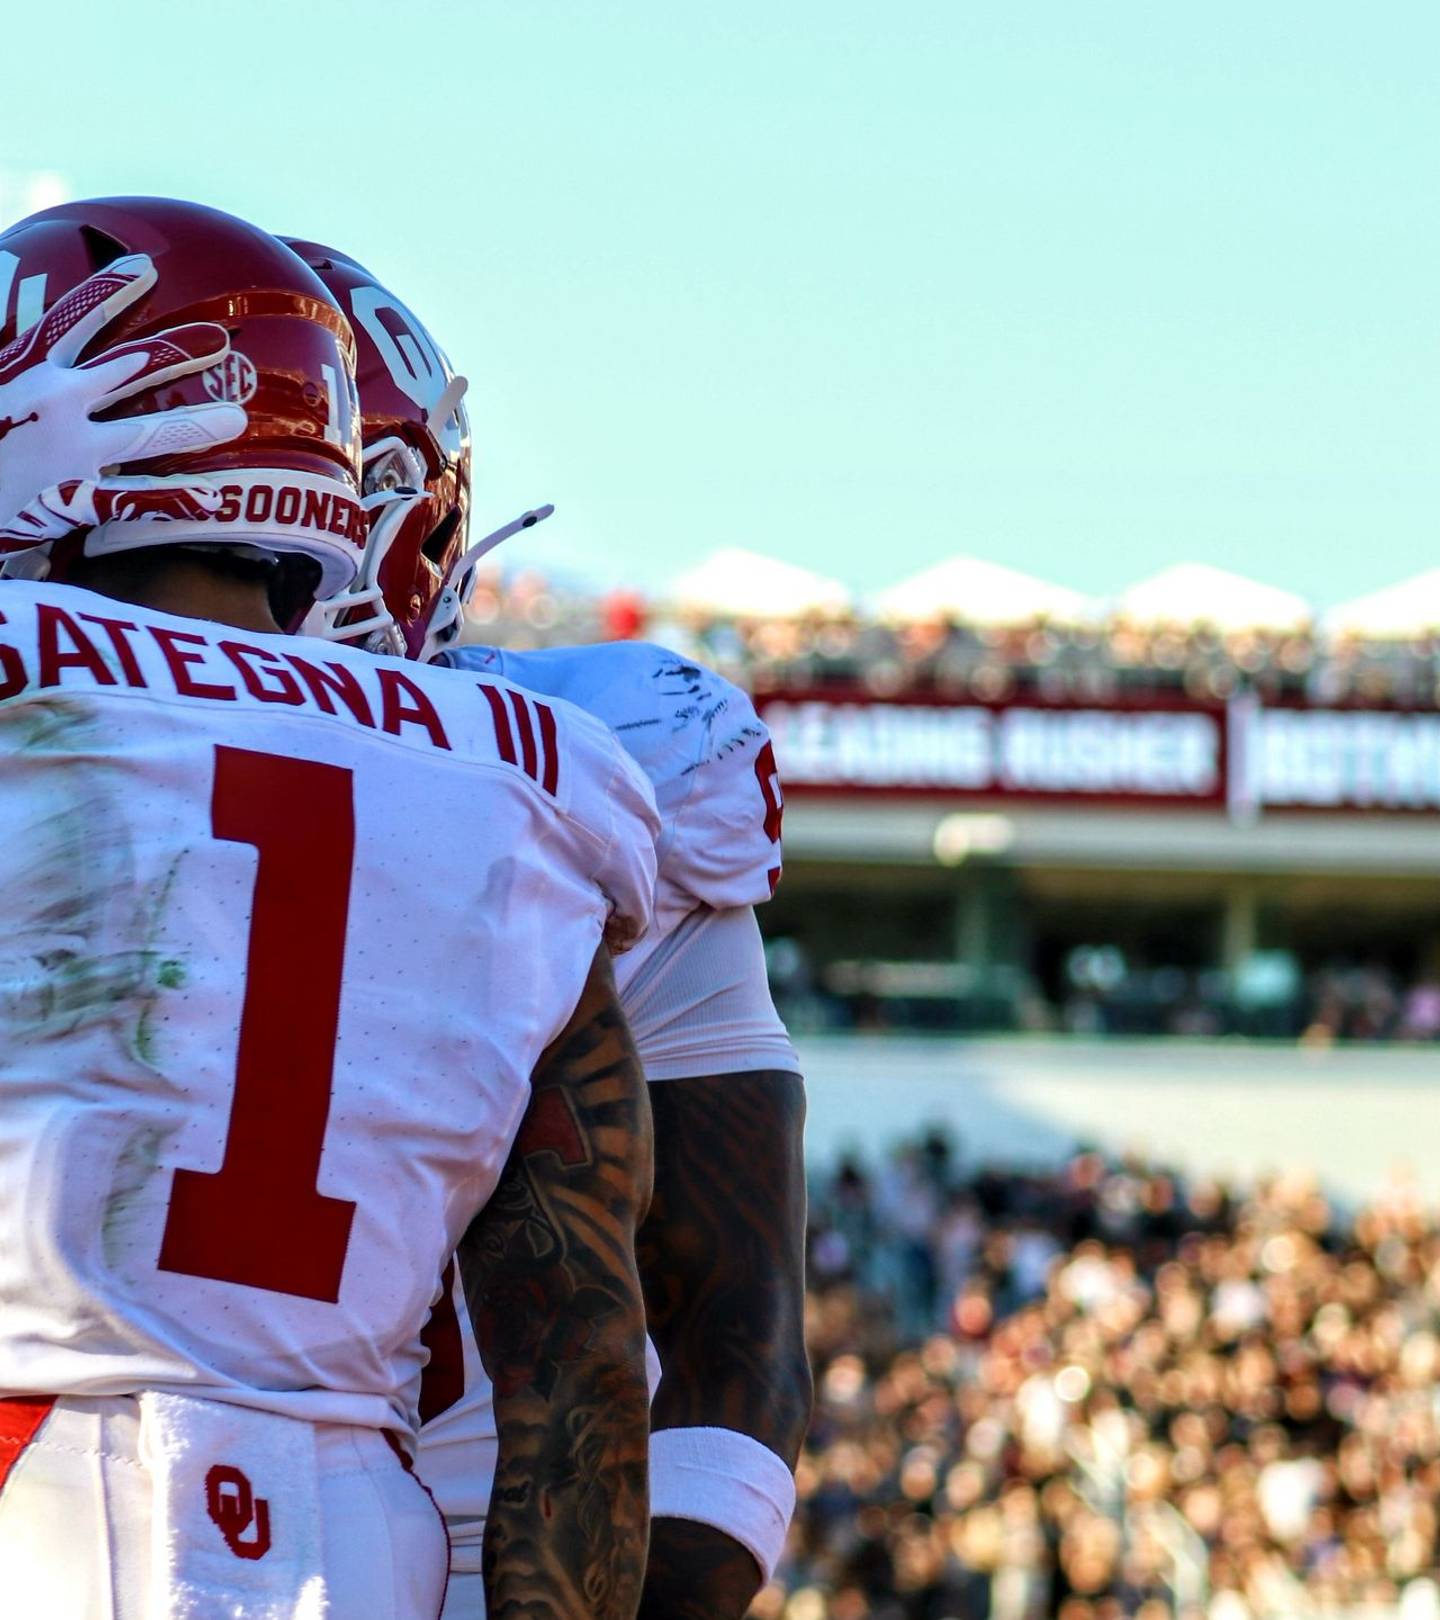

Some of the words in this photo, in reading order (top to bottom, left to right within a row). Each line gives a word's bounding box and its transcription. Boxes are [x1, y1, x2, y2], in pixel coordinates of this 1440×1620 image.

[206, 353, 254, 402] SEC
[321, 364, 342, 442] 1
[477, 683, 558, 797] III
[157, 743, 357, 1305] 1
[204, 1464, 272, 1560] OU
